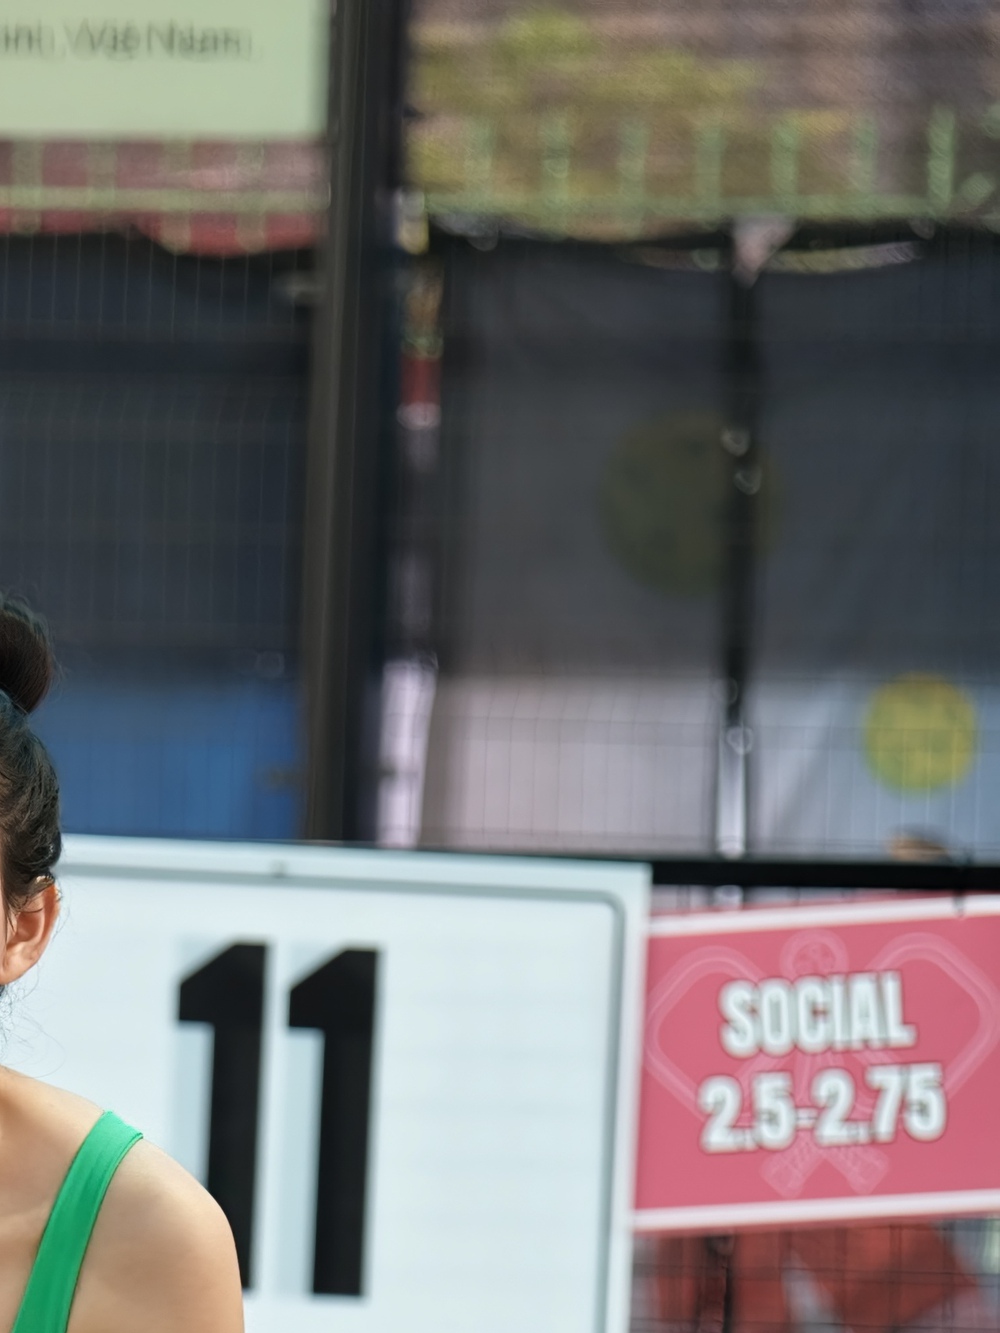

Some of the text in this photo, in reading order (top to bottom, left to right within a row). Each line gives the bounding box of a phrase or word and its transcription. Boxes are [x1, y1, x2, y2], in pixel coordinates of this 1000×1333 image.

[719, 970, 917, 1058] SOCIAL
[176, 941, 382, 1299] 11
[699, 1062, 947, 1153] 2.5-2.75
